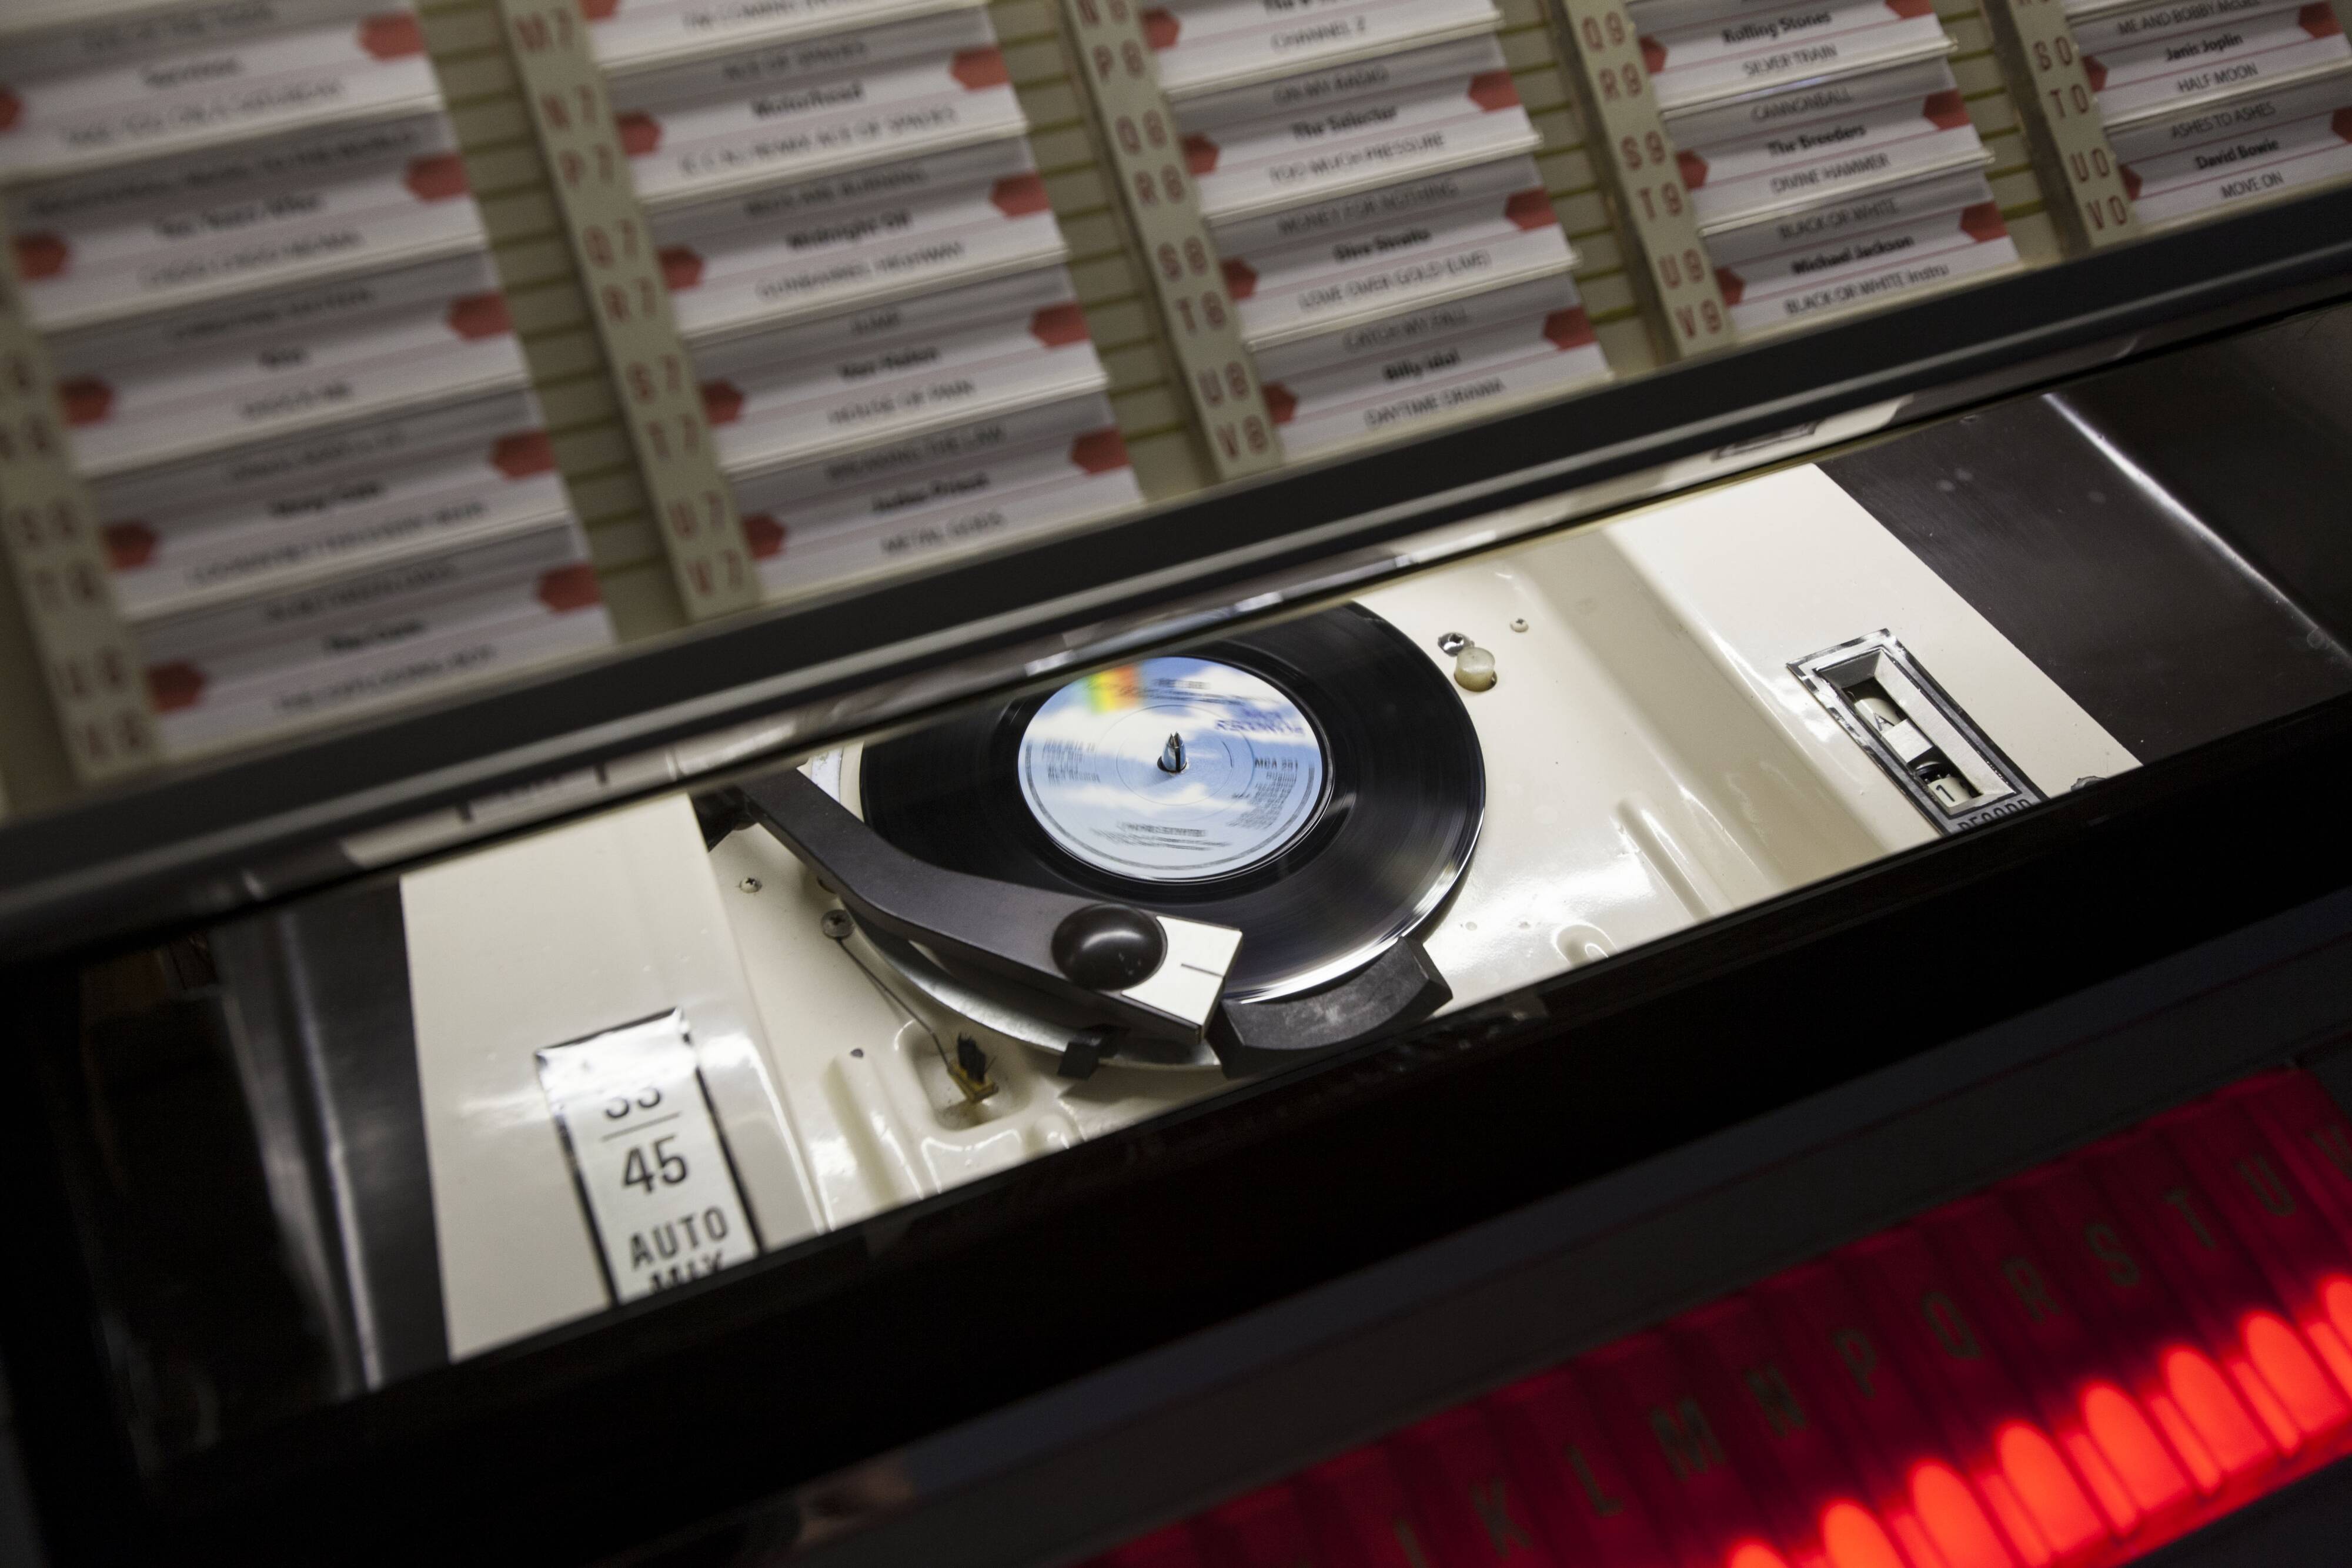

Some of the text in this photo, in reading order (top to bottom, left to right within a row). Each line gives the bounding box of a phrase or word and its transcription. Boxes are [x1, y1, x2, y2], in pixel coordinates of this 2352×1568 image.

[1722, 11, 1832, 45] Rolling Stones
[2117, 19, 2138, 35] ME
[2142, 12, 2171, 29] AND
[1741, 44, 1839, 79] SILVER TRAIN
[2166, 34, 2244, 62] Janis Joplin
[2177, 62, 2259, 93] HALF MOON
[1768, 123, 1867, 158] The Breeders
[2171, 101, 2276, 139] ASHES TO ASHES
[1770, 152, 1891, 195] DIVINE HAMMER
[2196, 138, 2279, 170] David Bowie
[2220, 171, 2284, 199] MOVE ON
[1778, 197, 1899, 240] BLACK OR WHITE
[1792, 236, 1915, 276] Michael Jackson
[1783, 290, 1831, 316] BLACK
[1833, 283, 1859, 303] OR
[1859, 273, 1905, 297] WHITE
[1936, 785, 1955, 803] 1
[622, 1133, 689, 1195] 45
[629, 1205, 729, 1271] AUTO
[2084, 1223, 2140, 1287] S
[2002, 1257, 2059, 1322] R
[1833, 1328, 1879, 1397] P
[1745, 1363, 1807, 1437] N
[1649, 1396, 1725, 1481] M
[1567, 1445, 1624, 1517] L
[1469, 1477, 1532, 1559] K
